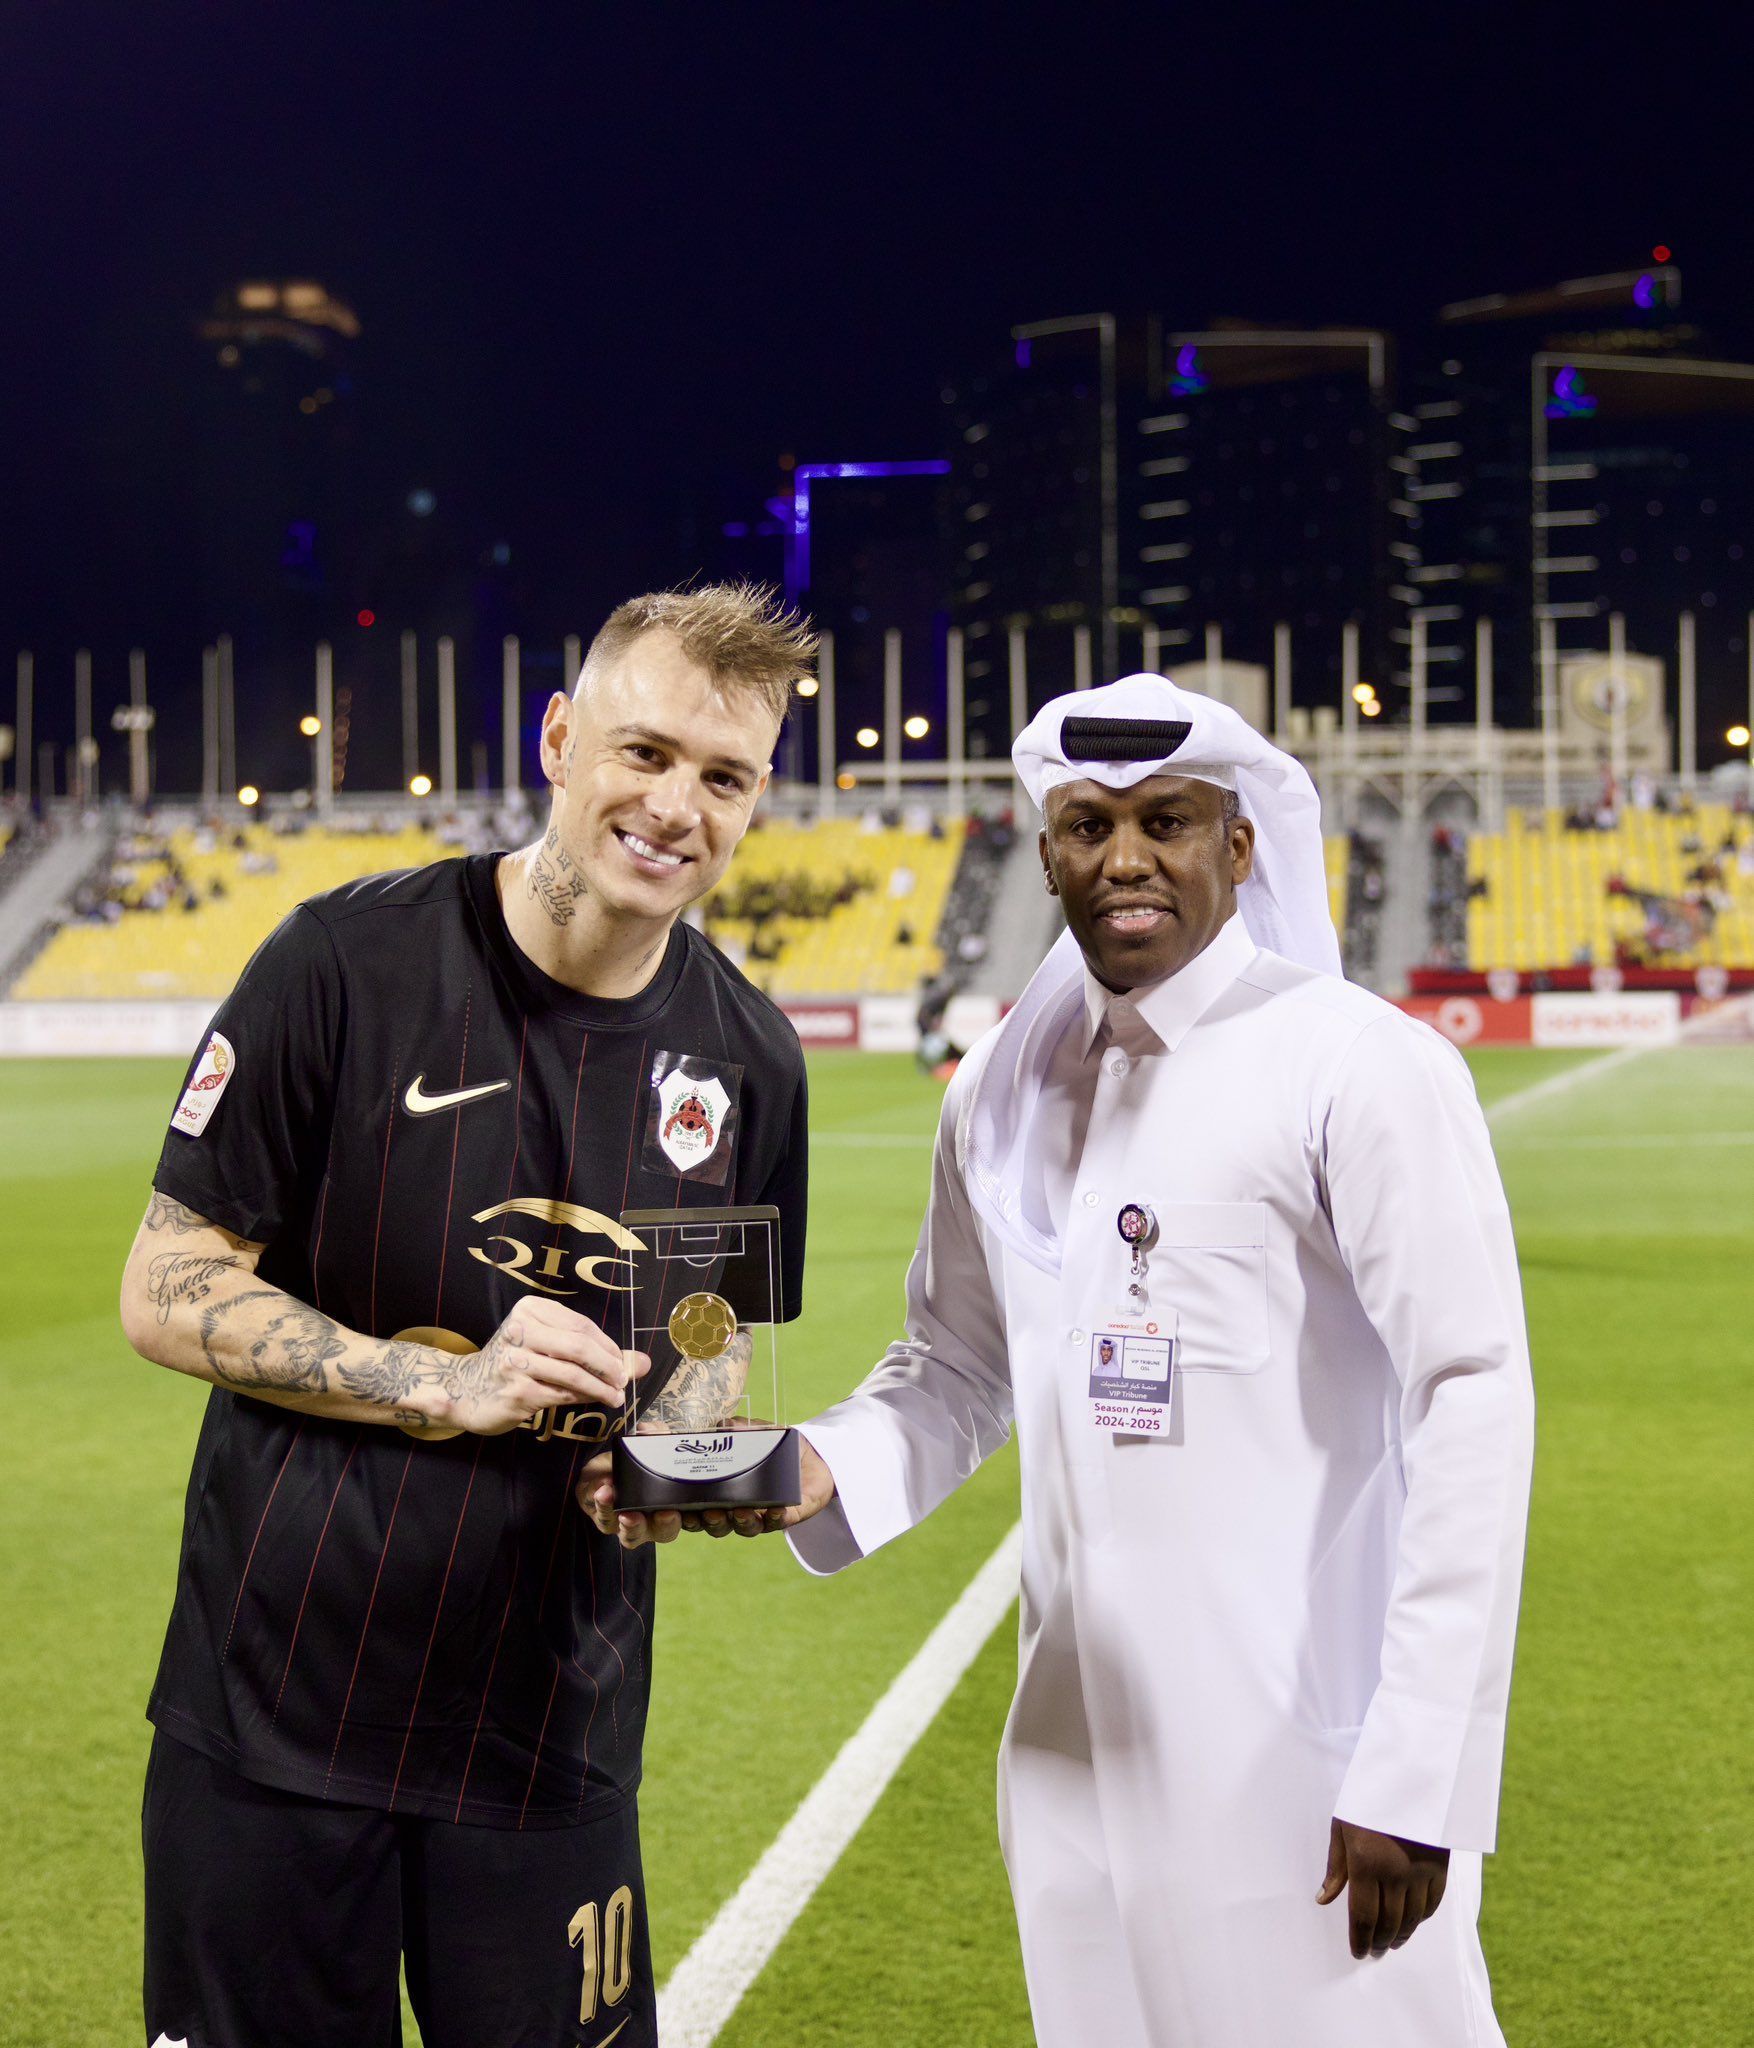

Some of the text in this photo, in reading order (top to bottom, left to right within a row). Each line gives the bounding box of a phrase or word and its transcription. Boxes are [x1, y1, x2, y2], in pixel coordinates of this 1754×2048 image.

[187, 1284, 211, 1304] 23
[1122, 1391, 1147, 1399] Tribune
[1094, 1403, 1128, 1413] Season
[1136, 1407, 1163, 1415] موسم
[1095, 1415, 1160, 1430] 2024-2025
[674, 1435, 733, 1457] الرابطة
[567, 1884, 633, 2026] 10
